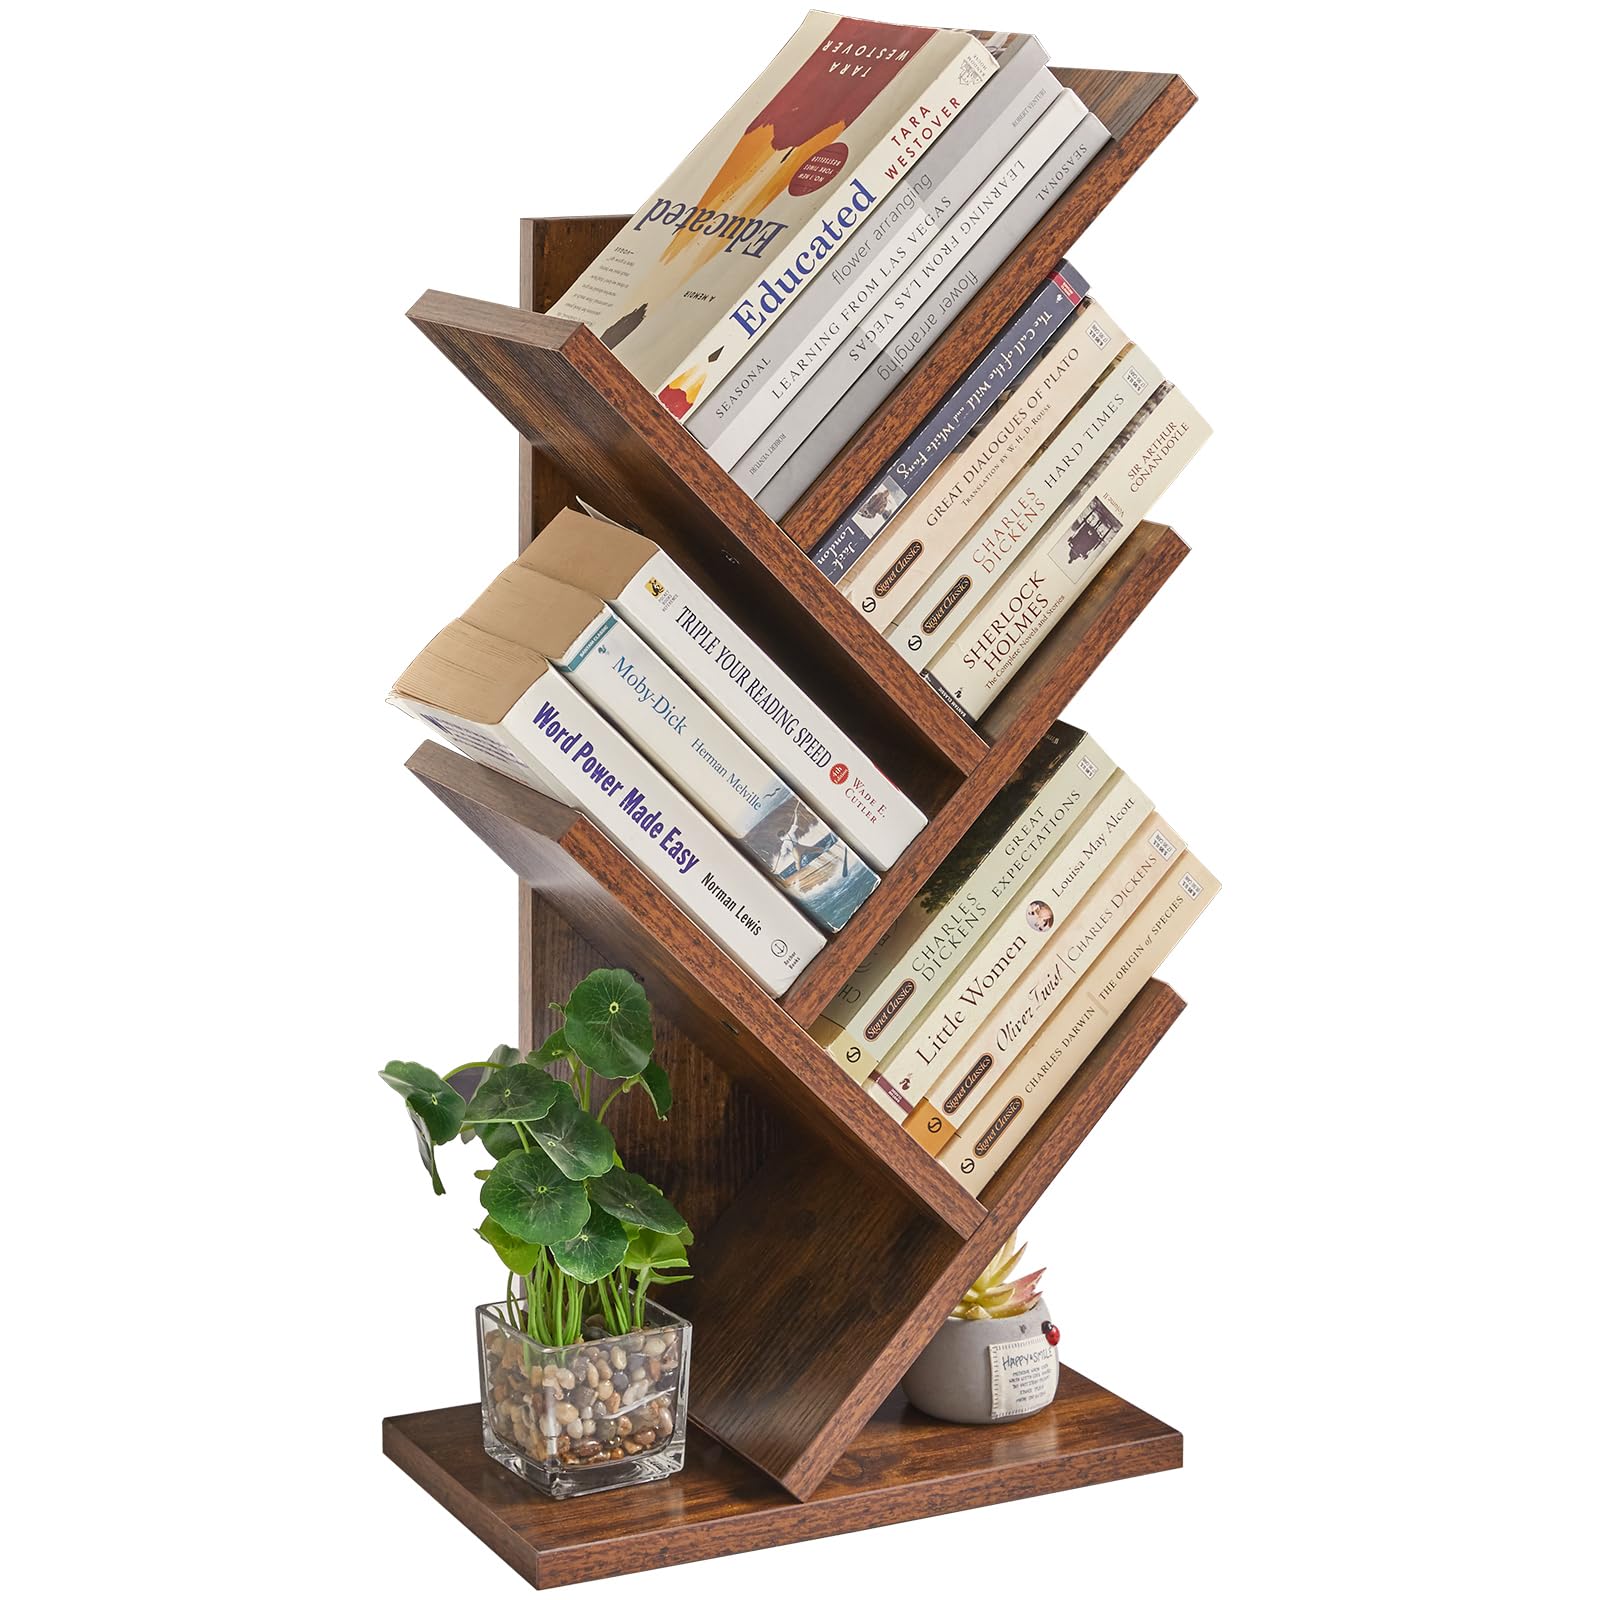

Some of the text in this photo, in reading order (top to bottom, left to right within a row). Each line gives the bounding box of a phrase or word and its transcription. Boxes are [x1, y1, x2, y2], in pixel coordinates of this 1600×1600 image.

[822, 40, 910, 62] WESTOVER
[829, 62, 872, 77] TARA
[884, 97, 961, 180] WESTOVER
[891, 106, 931, 146] TARA
[1012, 108, 1029, 128] ROBERT
[1035, 144, 1088, 202] SEASONAL
[633, 198, 788, 258] Educated
[729, 178, 877, 340] Educated
[832, 173, 933, 285] flower arranging
[849, 159, 1026, 362] LEARNING FROM LAS VEGAS
[683, 290, 709, 301] MEMOIR
[771, 196, 951, 400] LEARNING FROM LAS VEGAS
[877, 269, 980, 382] flower arranging
[1034, 310, 1052, 330] The
[989, 358, 1006, 382] the
[1002, 345, 1021, 370] of
[1016, 328, 1036, 356] Call
[715, 357, 772, 418] SEASONAL
[966, 381, 992, 412] Wild
[896, 452, 928, 480] Fang
[925, 423, 956, 454] White
[926, 347, 1080, 527] GREAT DIALOGUES OF PLATO
[961, 464, 1000, 508] TRANSLATION
[999, 454, 1010, 466] BY
[1008, 444, 1018, 454] W.
[1016, 434, 1025, 445] H.
[1023, 426, 1032, 436] D.
[1044, 393, 1125, 488] HARD TIMES
[1128, 420, 1178, 480] SIR ARTHUR
[1130, 422, 1190, 494] CONAN DOYLE
[972, 487, 1038, 564] CHARLES
[982, 498, 1046, 575] DICKENS
[1109, 496, 1126, 518] Volume
[817, 526, 856, 566] London
[832, 542, 856, 570] Jack
[876, 542, 922, 595] Signet Classics
[922, 576, 970, 634] Signet Classics
[962, 571, 1046, 670] SHERLOCK
[984, 594, 1049, 672] HOLMES
[985, 594, 1066, 690] The Complete Novels and Stories
[612, 656, 688, 736] Moby-Dick
[676, 606, 832, 769] TRIPLE YOUR READING SPEED
[532, 701, 700, 874] Word Power Made Easy
[691, 738, 762, 811] Herman Melville
[844, 788, 876, 824] CUTLER
[852, 777, 886, 818] WADE E.
[991, 790, 1082, 898] EXPECTATIONS
[1004, 806, 1044, 856] GREAT
[1051, 796, 1136, 898] Louisa May Alcott
[701, 872, 762, 936] Norman Lewis
[911, 894, 977, 972] CHARLES
[1067, 856, 1157, 962] CHARLES DICKENS
[920, 903, 987, 982] DICKENS
[1098, 896, 1184, 1000] THE ORIGIN of SPECIES
[867, 1010, 892, 1038] Signet
[886, 981, 914, 1016] Classics
[915, 934, 1028, 1066] Little Women
[996, 964, 1063, 1052] Oliver Twist
[1024, 1006, 1095, 1094] CHARLES DARWIN
[944, 1055, 992, 1115] Signet Classics
[976, 1097, 1022, 1156] Signet Classics
